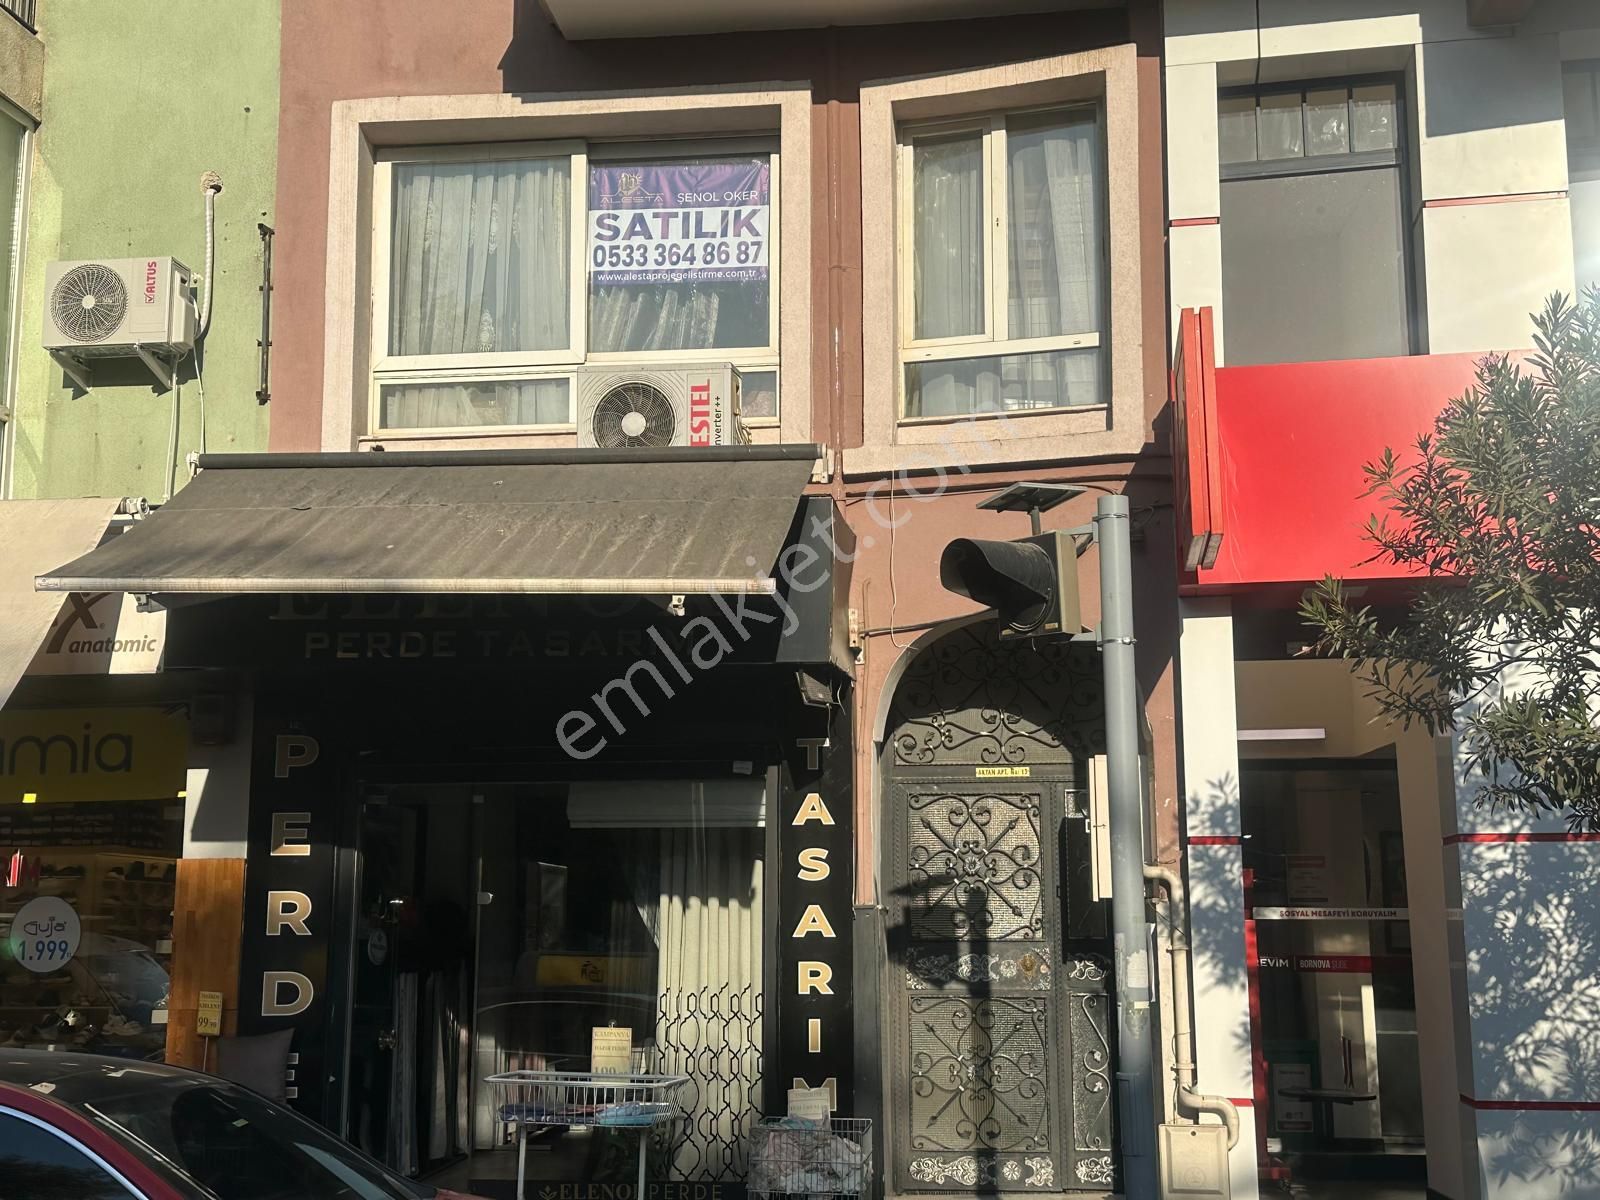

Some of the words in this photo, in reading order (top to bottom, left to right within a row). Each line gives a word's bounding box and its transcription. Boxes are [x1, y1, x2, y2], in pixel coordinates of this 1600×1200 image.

[677, 192, 720, 205] ŞENOL
[723, 190, 758, 202] OKER
[594, 208, 761, 241] SATILIK
[593, 244, 648, 267] 0533
[653, 242, 697, 266] 364
[701, 241, 730, 265] 86
[736, 240, 763, 264] 87
[145, 261, 157, 293] ALTUS
[690, 379, 710, 447] ESTEL
[714, 396, 722, 446] nverter++
[68, 634, 157, 654] anatomic
[303, 631, 457, 659] PERDE
[0, 721, 133, 776] mia
[19, 940, 68, 960] 1.999
[1257, 958, 1288, 968] EVİM
[1300, 960, 1330, 969] BORNOVA
[649, 1184, 722, 1200] PERDE
